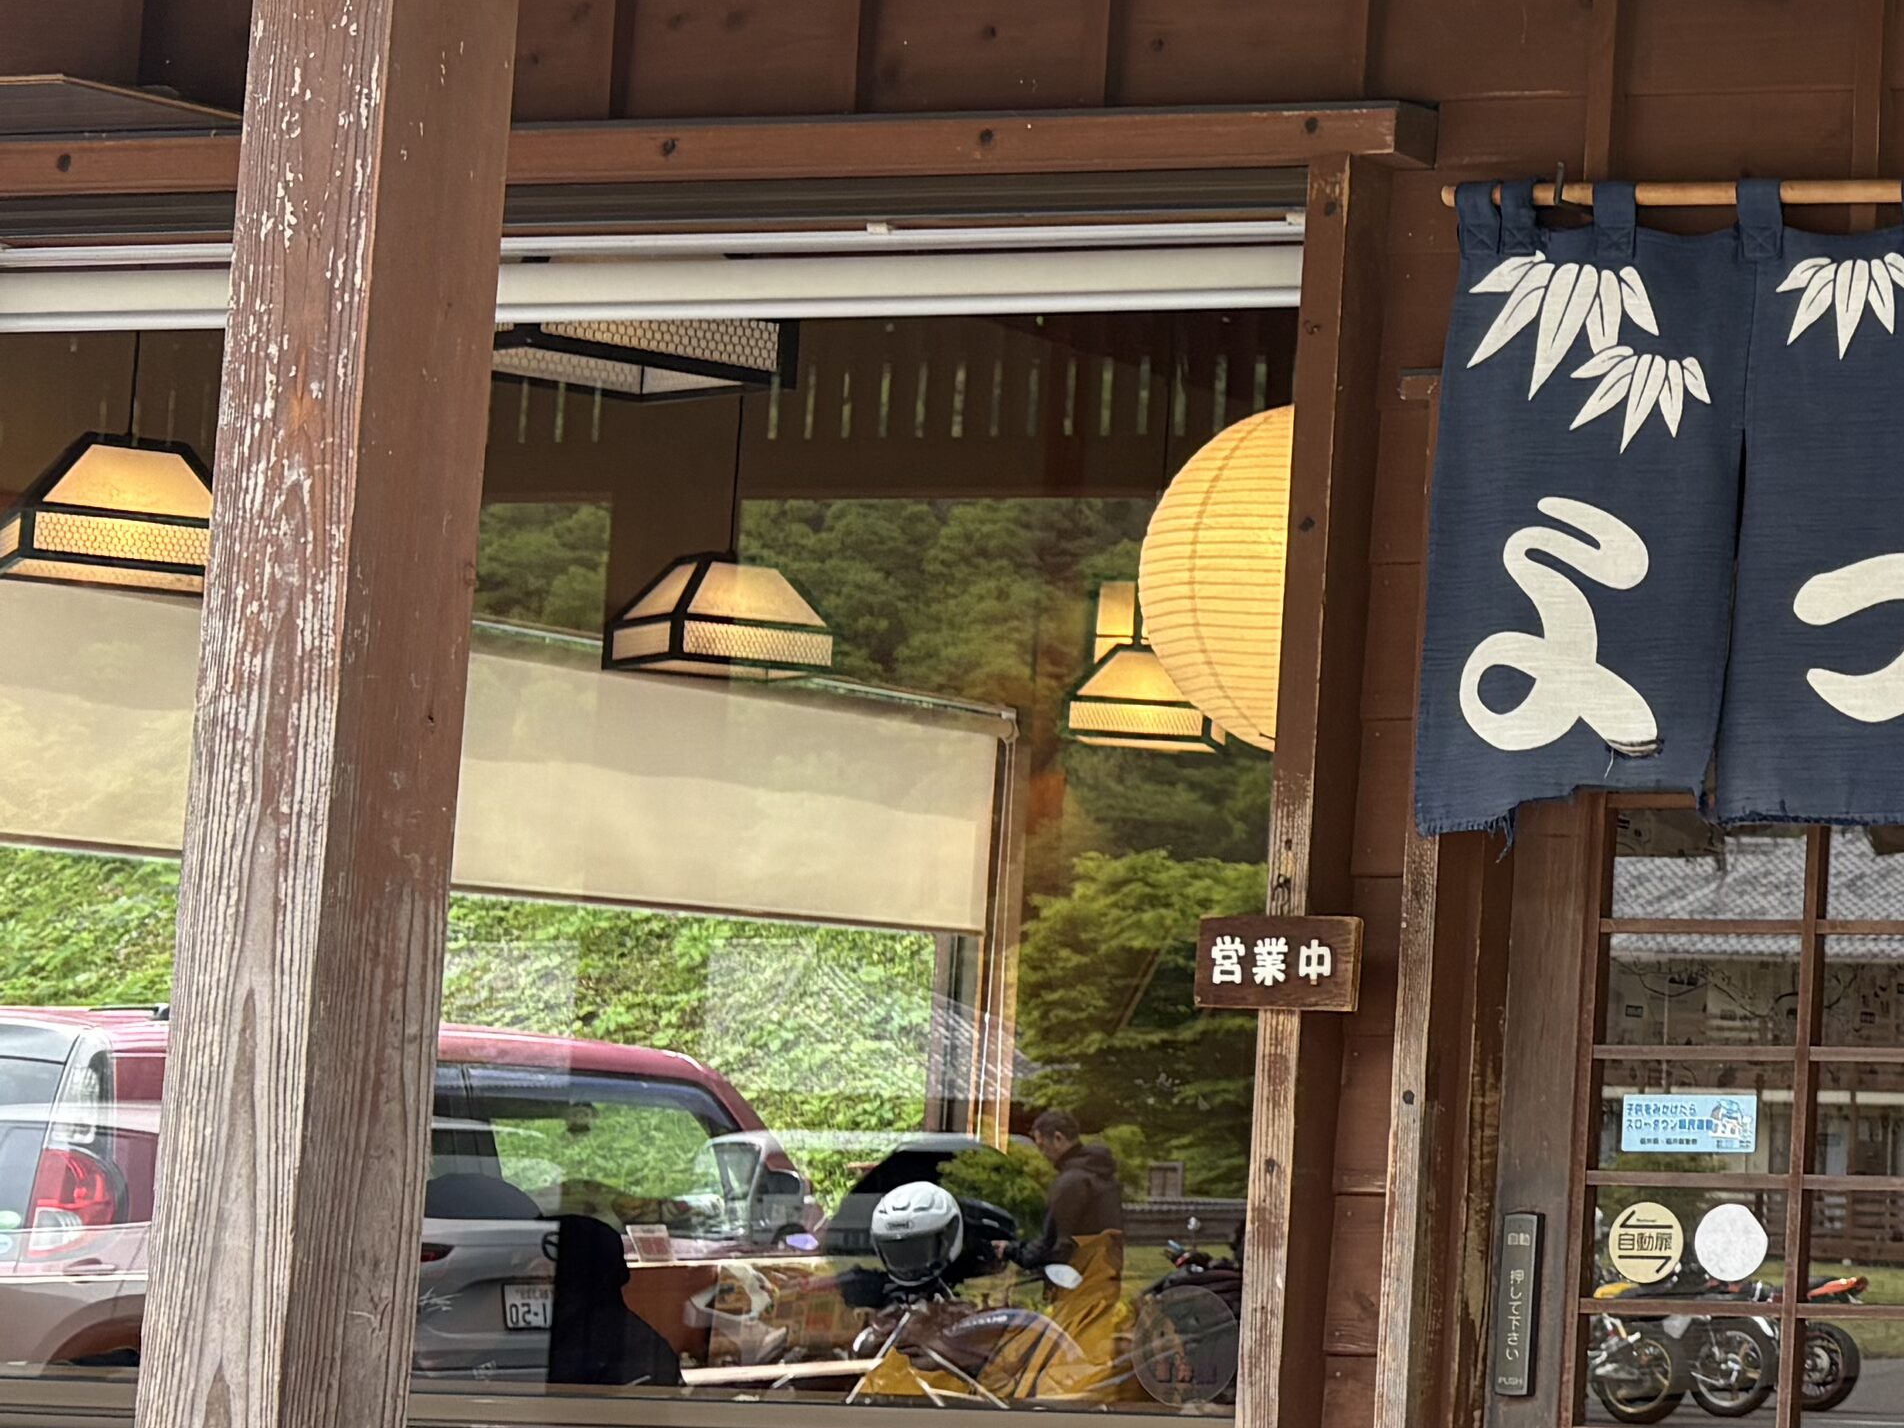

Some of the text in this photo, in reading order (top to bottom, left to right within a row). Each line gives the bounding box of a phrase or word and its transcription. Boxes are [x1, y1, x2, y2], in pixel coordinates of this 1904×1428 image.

[1211, 936, 1332, 985] 営業中
[1618, 1233, 1672, 1251] 自動扉
